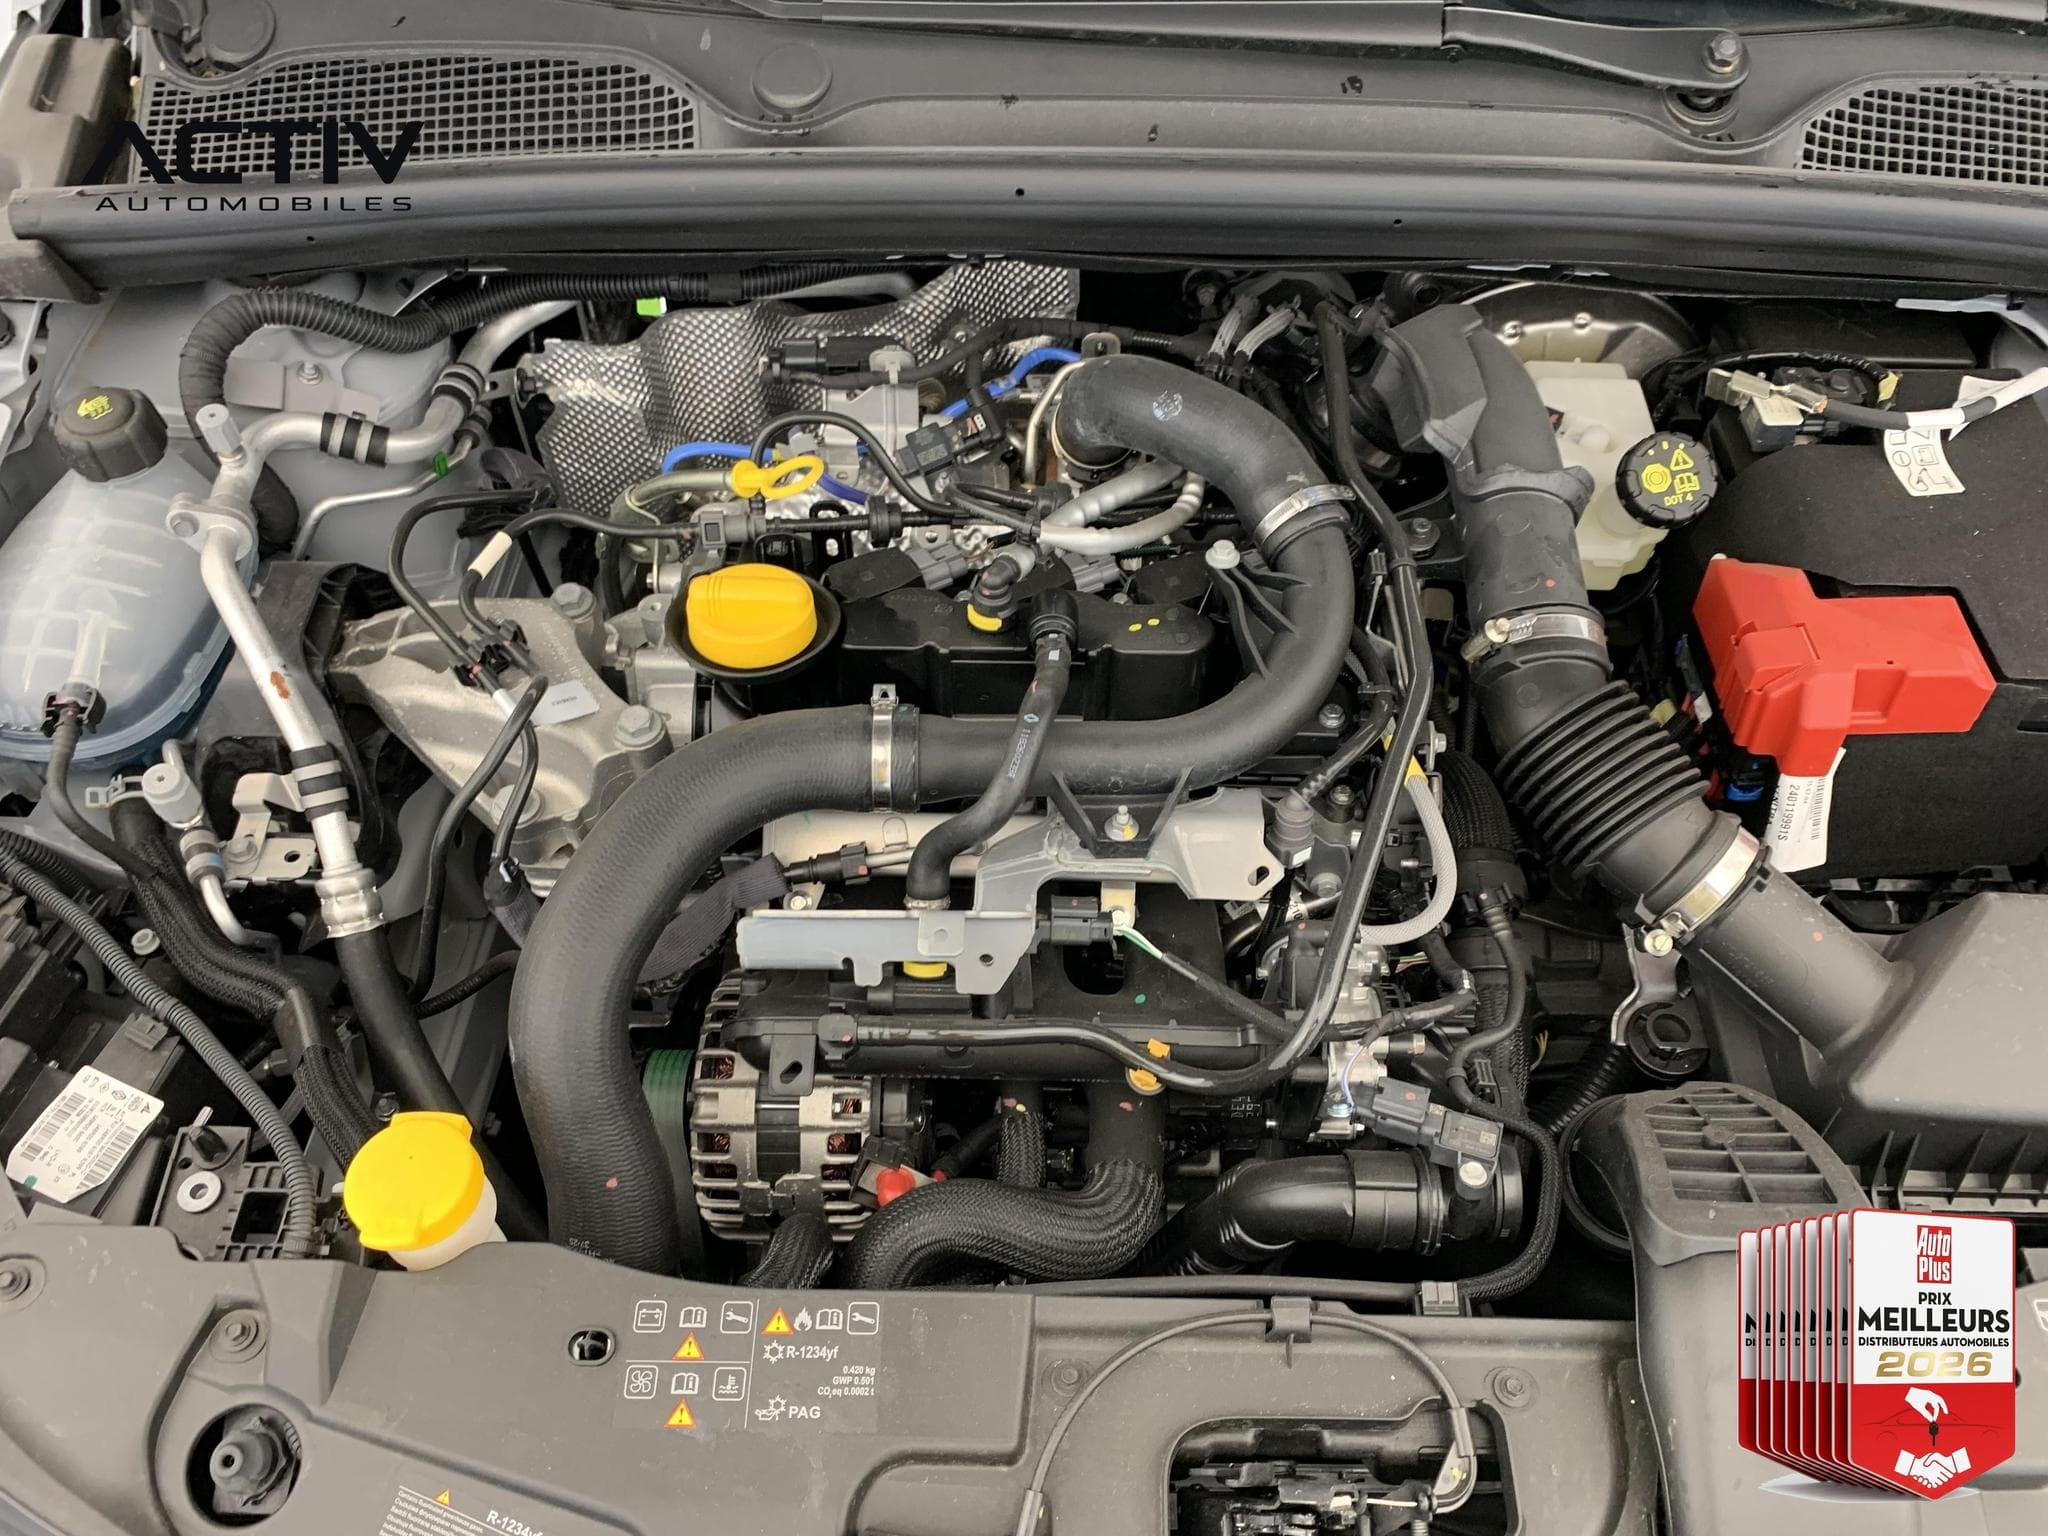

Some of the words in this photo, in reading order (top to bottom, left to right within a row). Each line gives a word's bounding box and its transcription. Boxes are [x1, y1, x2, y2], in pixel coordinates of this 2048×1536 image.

[1664, 494, 1683, 506] DOT
[1686, 493, 1693, 502] 4
[786, 1345, 839, 1362] R-1234yf
[865, 1366, 876, 1376] kg
[832, 1376, 852, 1385] GWP
[788, 1406, 821, 1419] PAG
